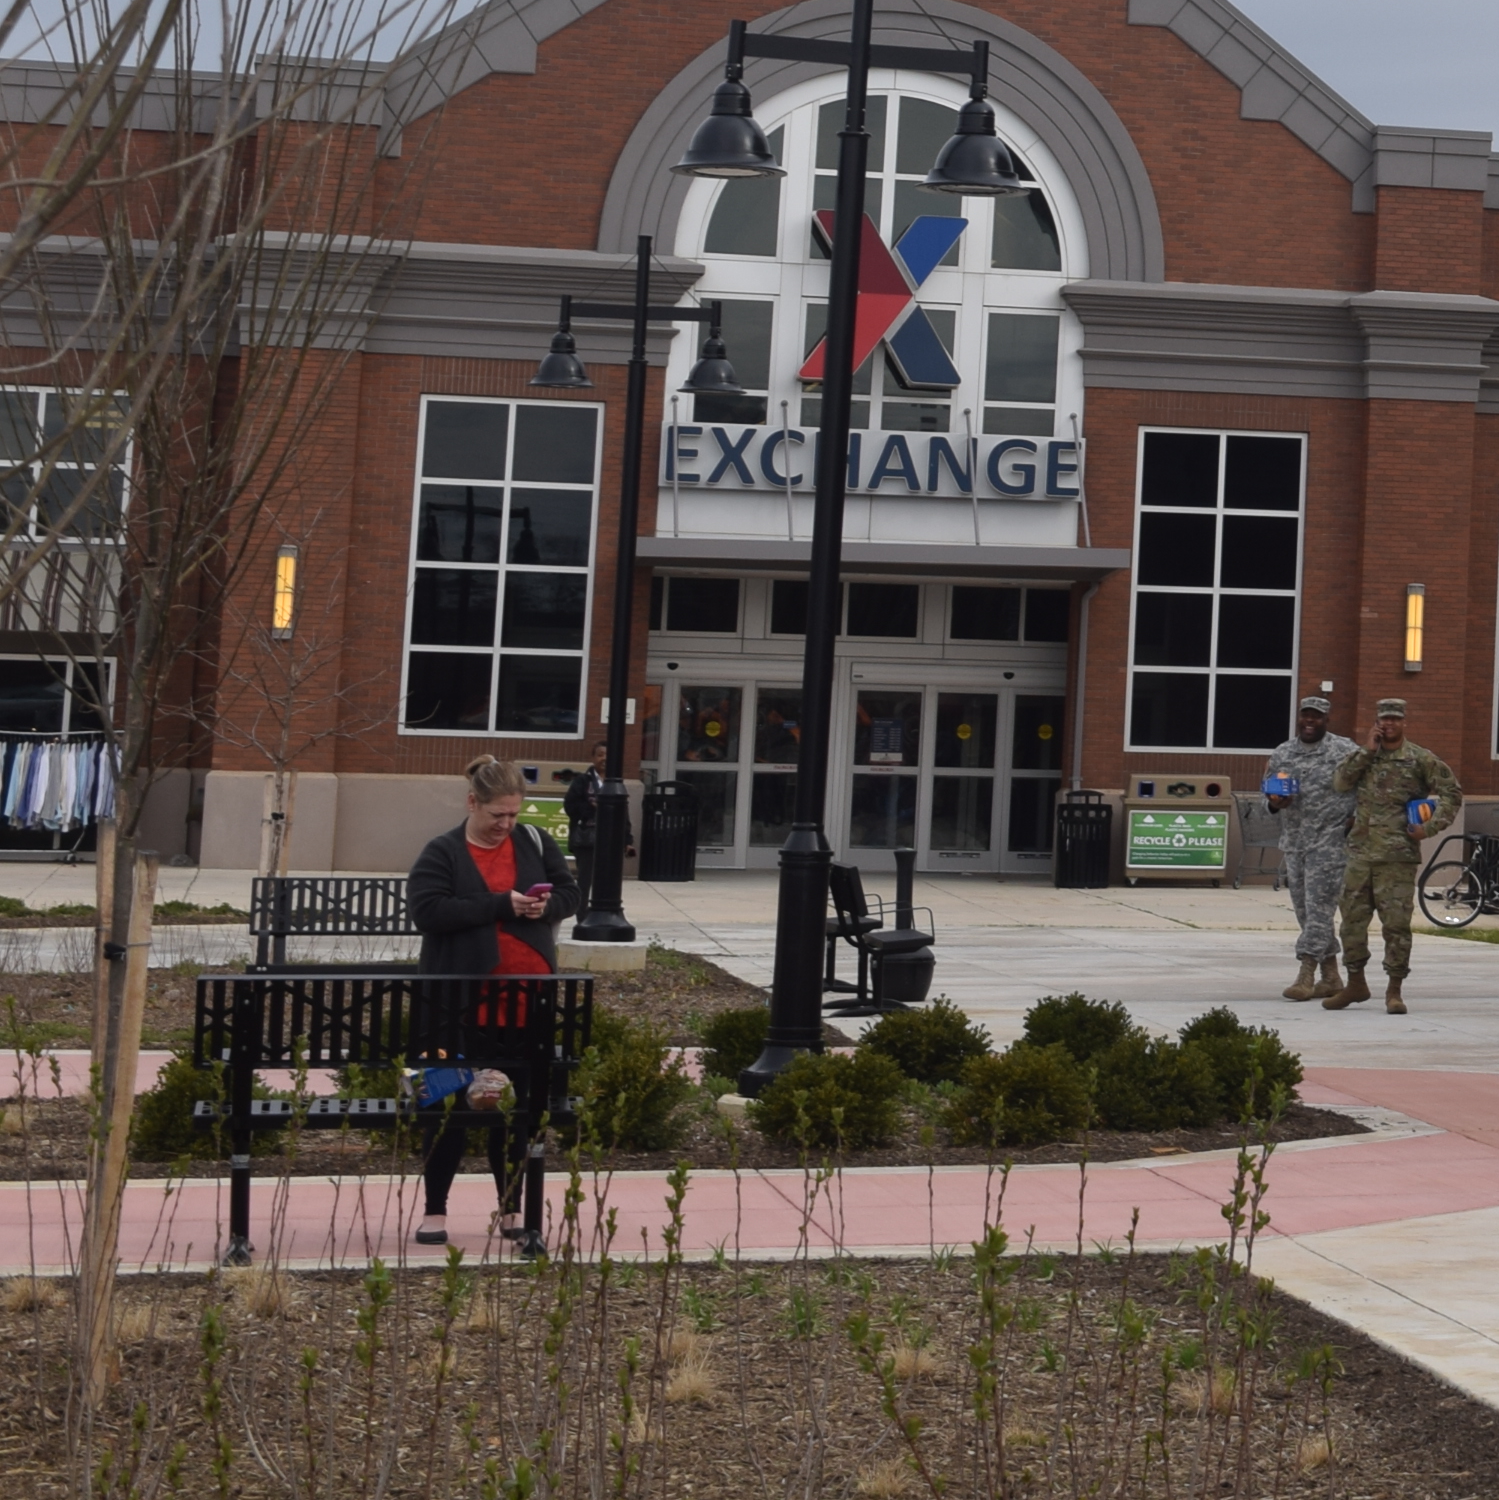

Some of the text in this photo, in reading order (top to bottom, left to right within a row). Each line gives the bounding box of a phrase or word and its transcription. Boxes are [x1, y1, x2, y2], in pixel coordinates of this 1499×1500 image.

[664, 425, 1082, 497] EXCHANGE
[1133, 836, 1223, 846] RECYCLE PLEASE
